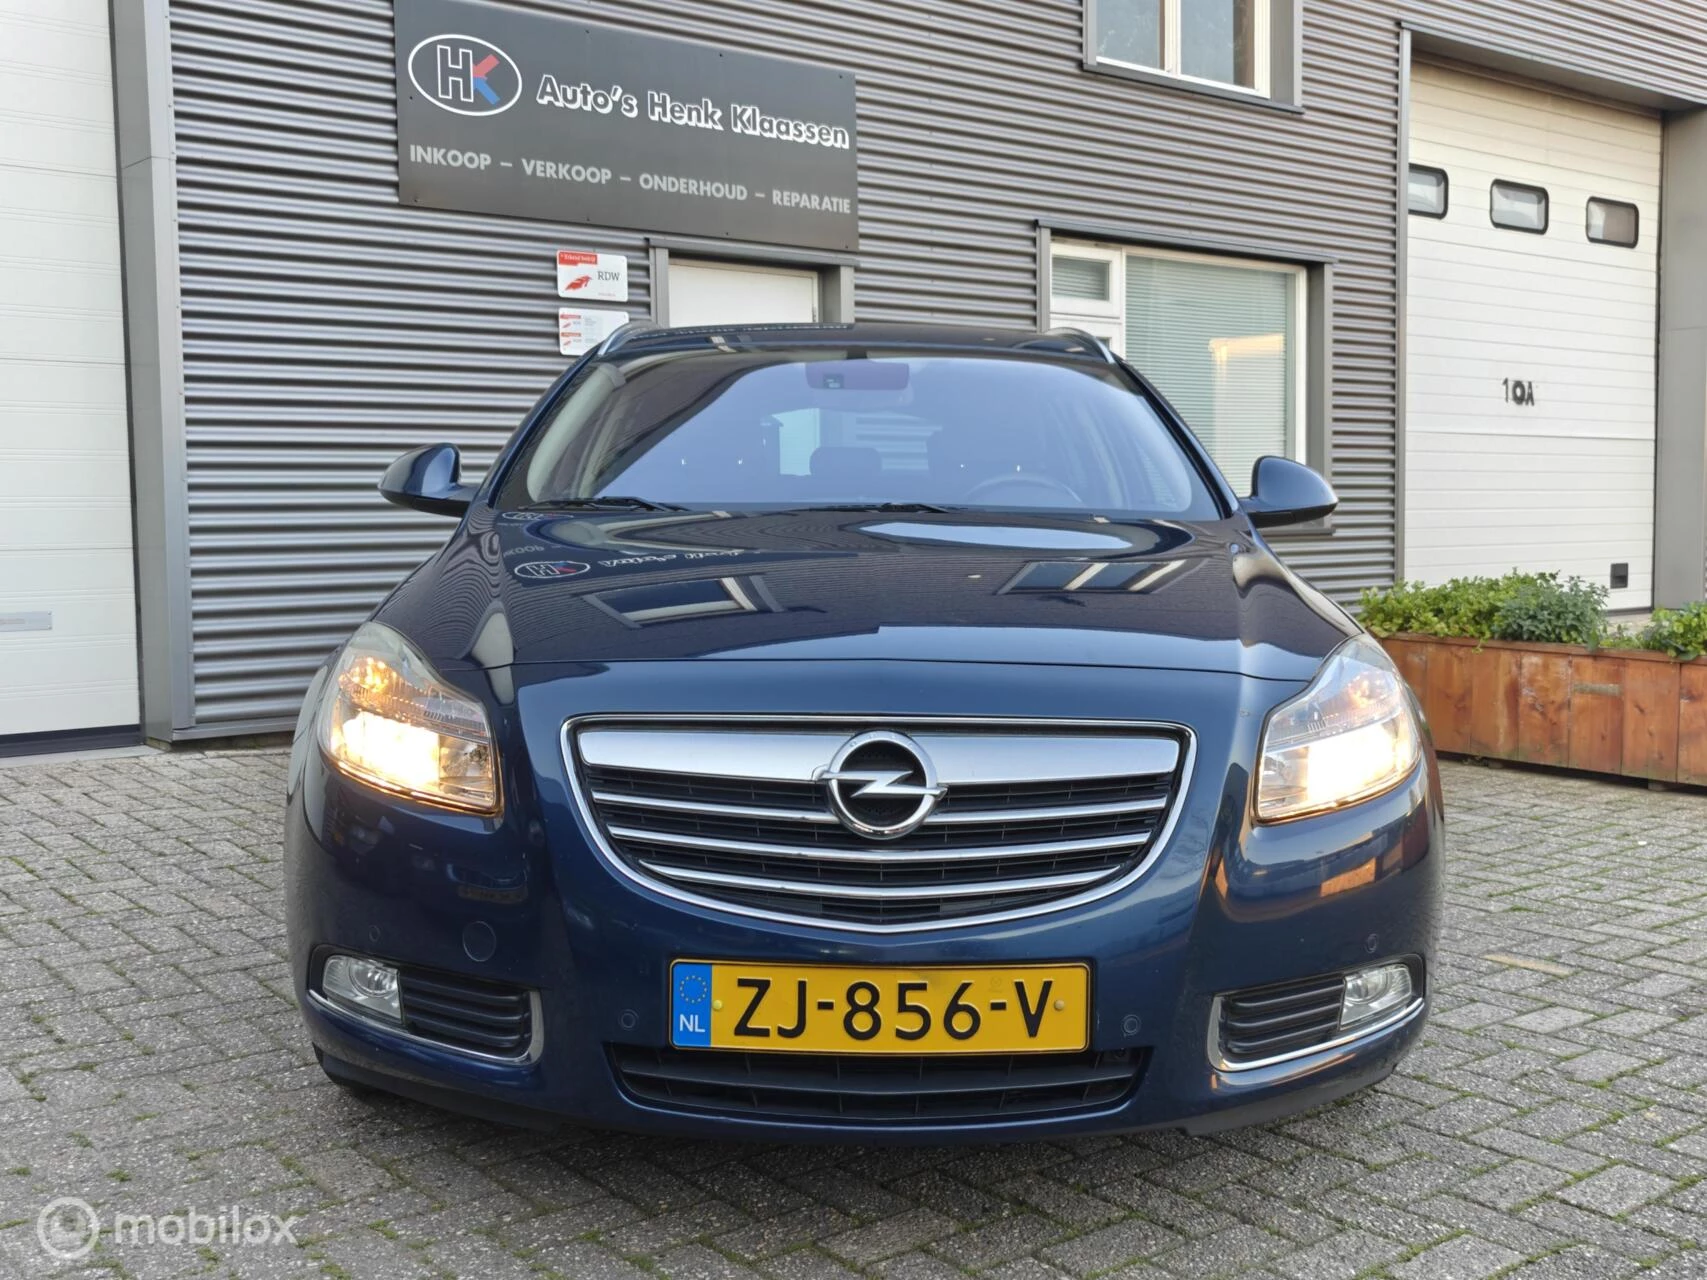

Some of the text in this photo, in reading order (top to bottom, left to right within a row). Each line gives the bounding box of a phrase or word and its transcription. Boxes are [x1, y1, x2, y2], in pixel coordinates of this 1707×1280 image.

[536, 74, 850, 149] Auto's Henk Klaassen
[409, 144, 492, 170] INKOOP
[521, 157, 612, 184] VERKOOP
[639, 173, 748, 201] ONDERHOUD
[772, 189, 851, 214] REPARATIE
[597, 271, 620, 281] RDW
[1502, 377, 1534, 406] 10A
[679, 977, 1053, 1041] NL ZJ-856-V
